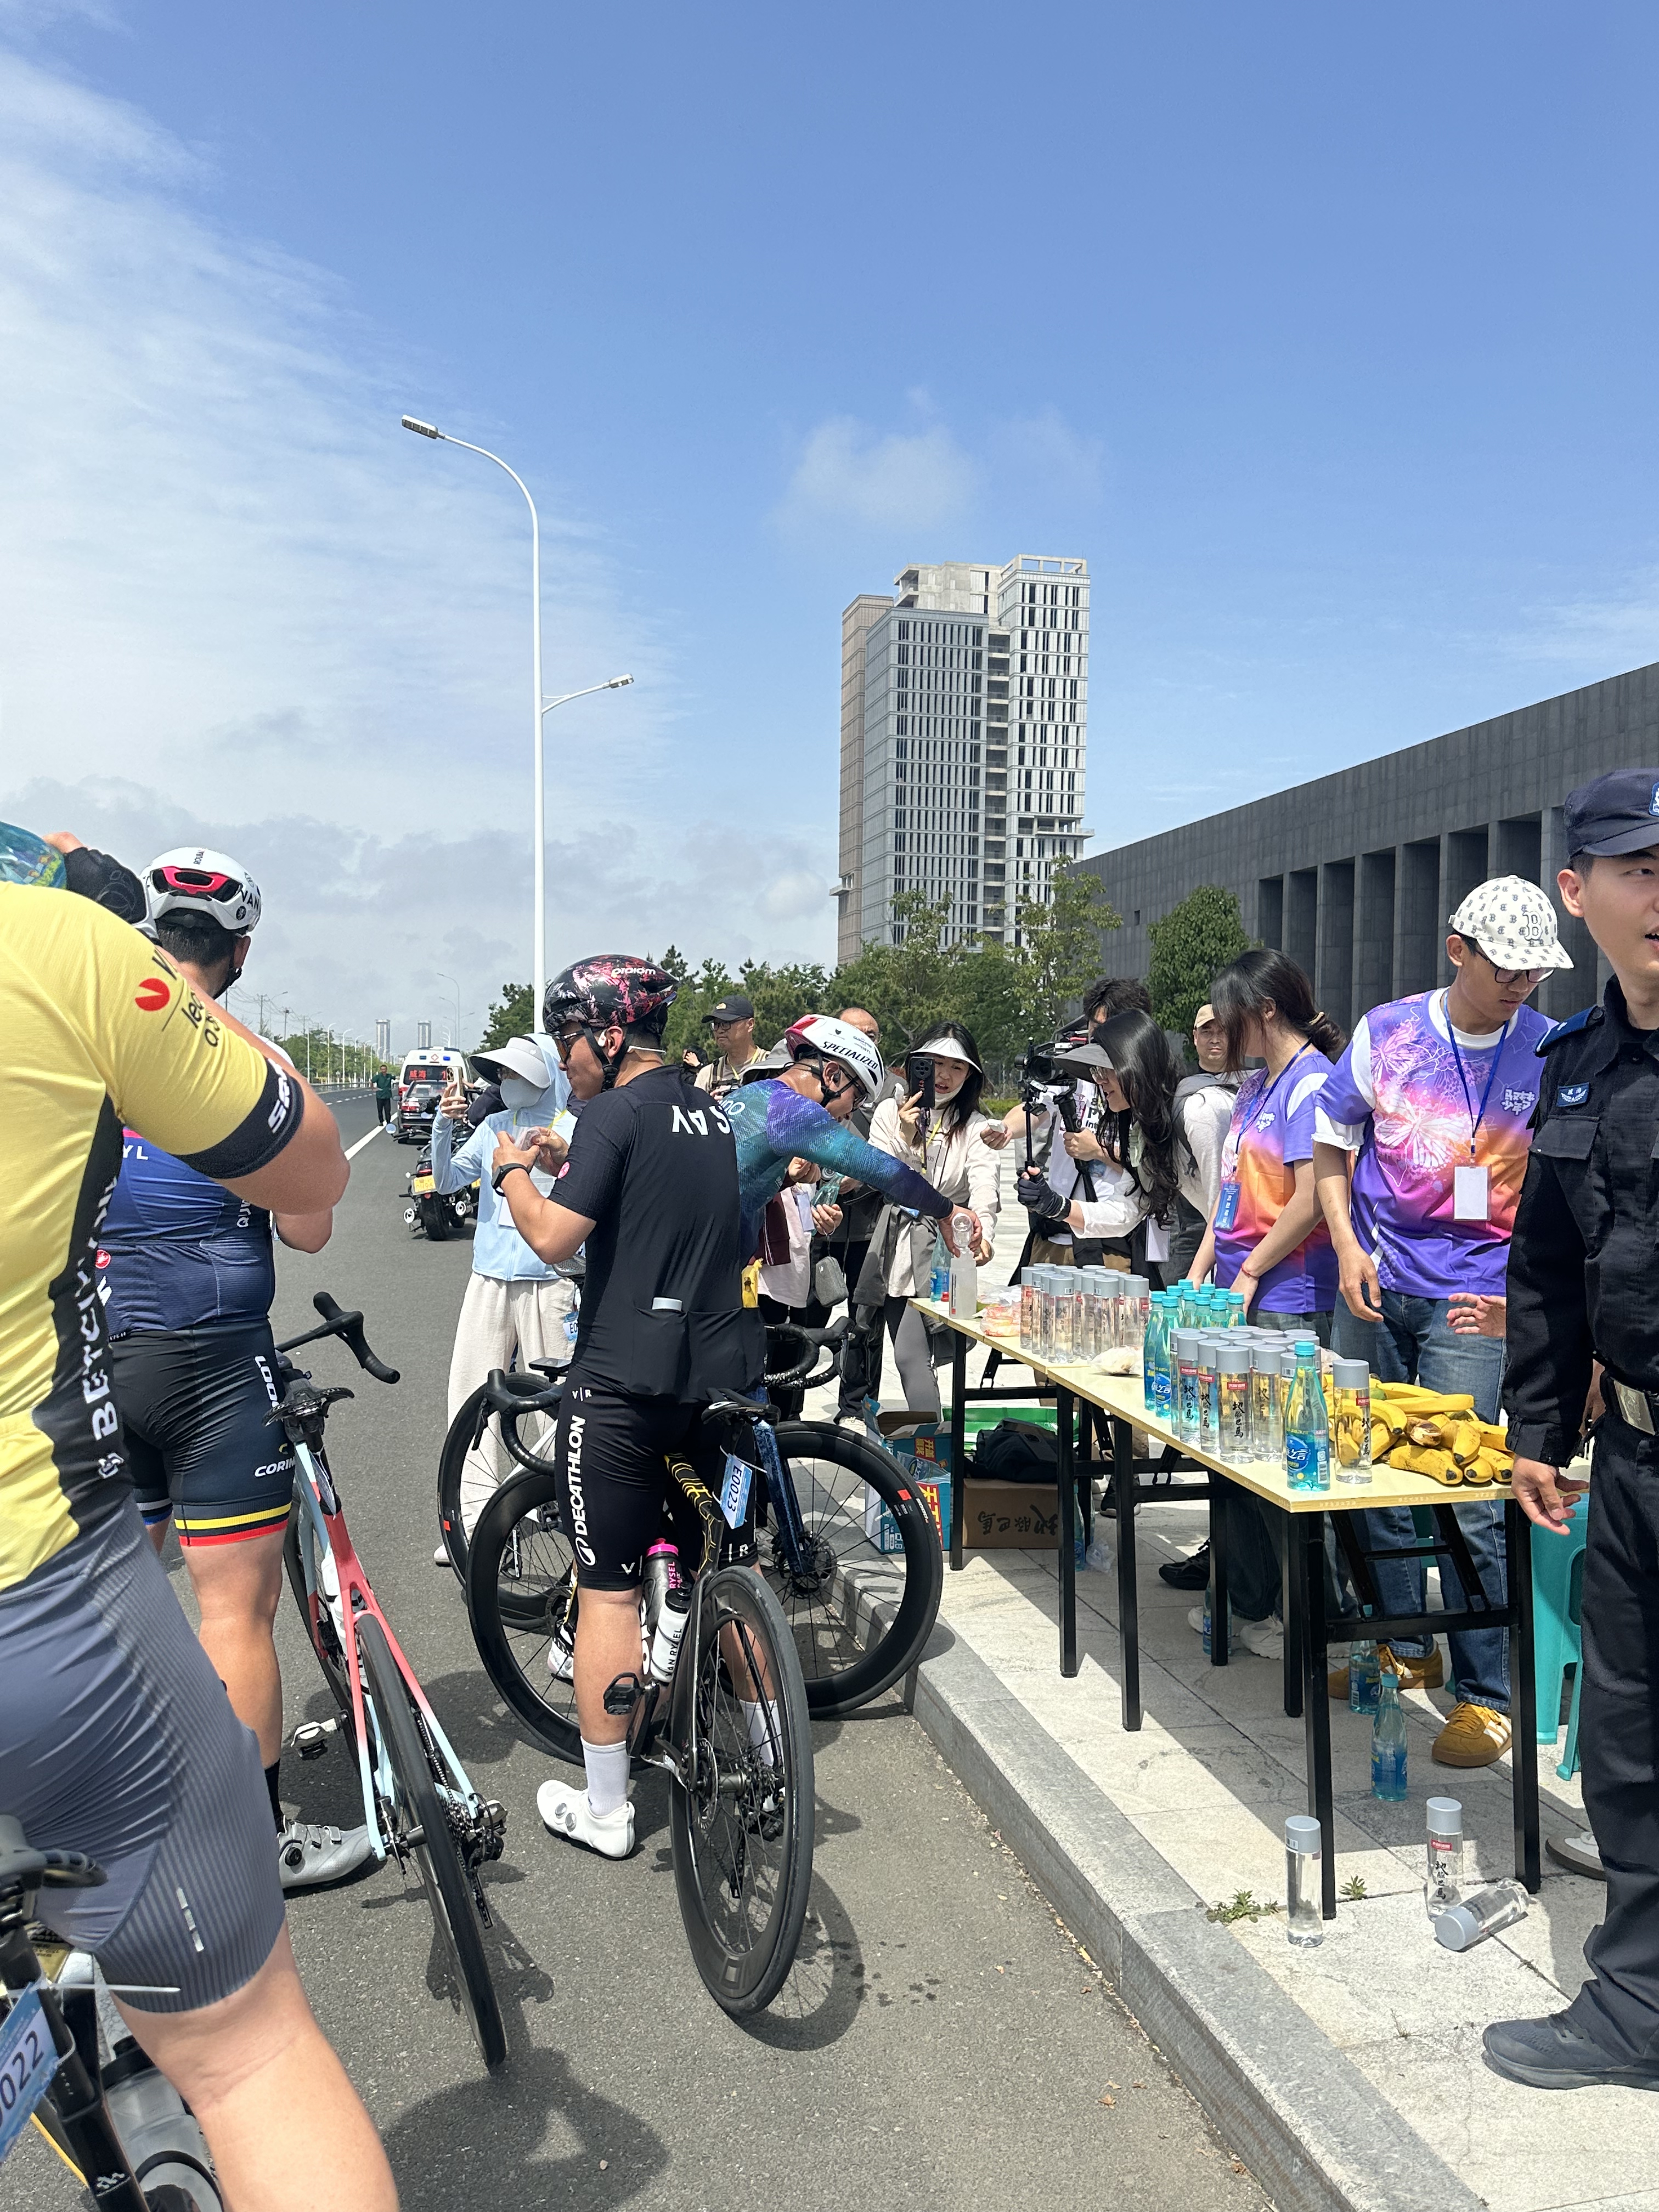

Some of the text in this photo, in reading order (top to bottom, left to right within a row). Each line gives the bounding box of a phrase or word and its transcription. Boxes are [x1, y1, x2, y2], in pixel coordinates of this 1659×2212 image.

[821, 1041, 878, 1070] SPECIALIZED
[567, 1415, 588, 1536] DECATHLON
[727, 1464, 743, 1513] E0023
[668, 1561, 676, 1589] RYSEL
[670, 1628, 682, 1656] RYEL
[0, 2030, 44, 2112] 022
